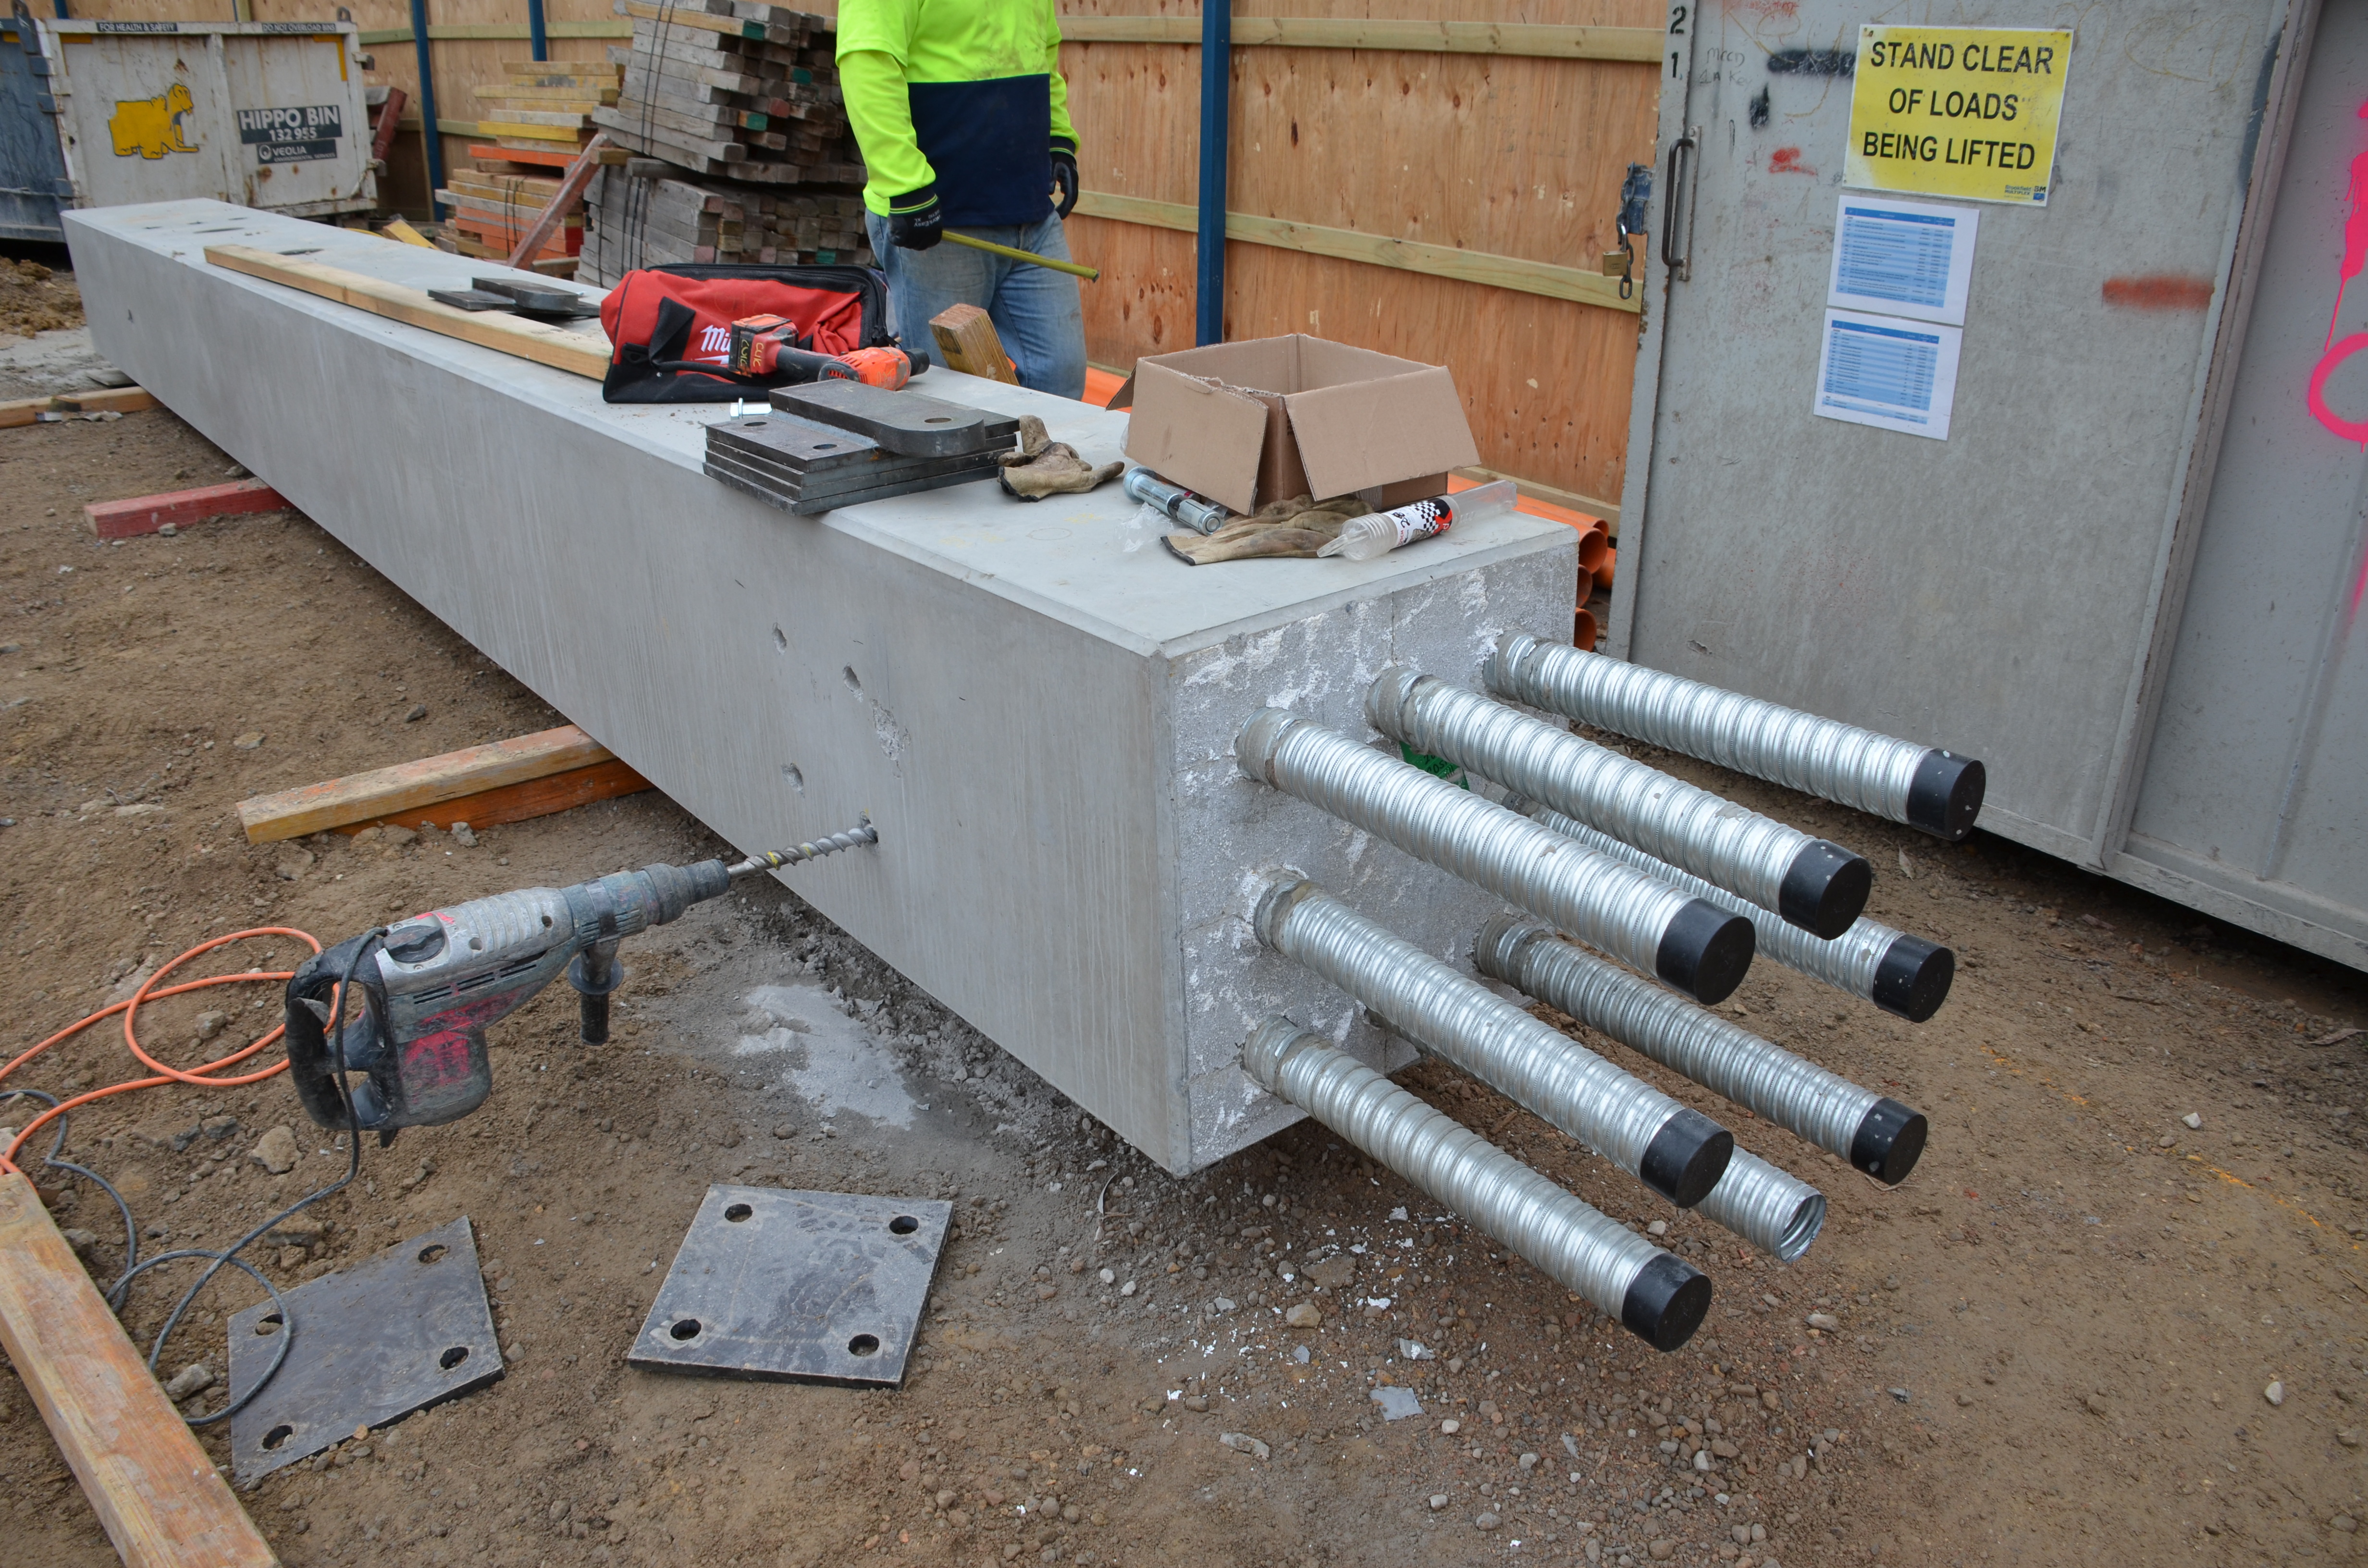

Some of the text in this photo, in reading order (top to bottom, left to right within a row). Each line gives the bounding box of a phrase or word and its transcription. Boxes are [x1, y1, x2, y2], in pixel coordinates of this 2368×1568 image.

[150, 23, 174, 31] SAFETY
[1870, 41, 2053, 74] STAND CLEAR
[1889, 87, 2018, 121] OF LOADS
[239, 106, 340, 130] HIPPO BIN
[269, 126, 317, 141] 132 955
[272, 146, 307, 156] VEOLIA
[1863, 132, 2035, 171] BEING LIFTED
